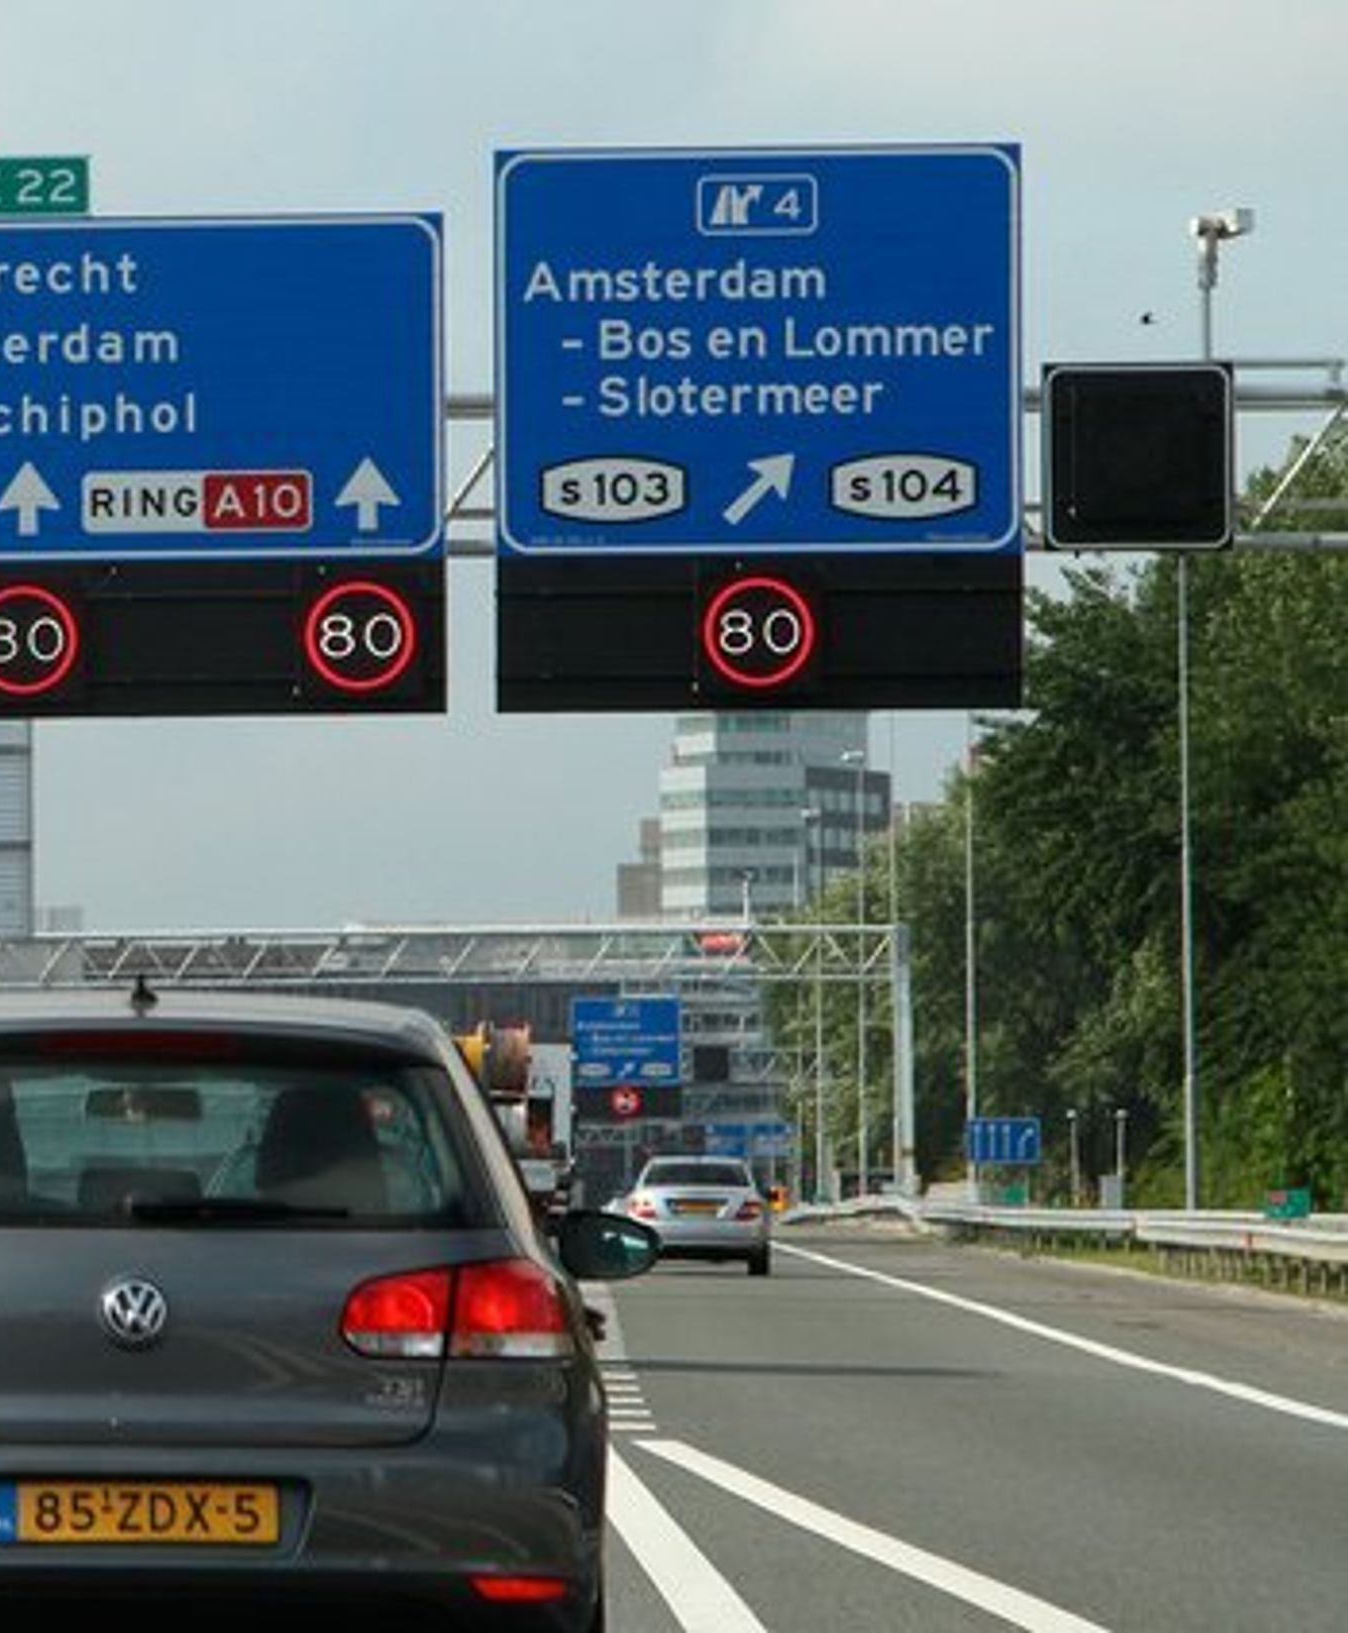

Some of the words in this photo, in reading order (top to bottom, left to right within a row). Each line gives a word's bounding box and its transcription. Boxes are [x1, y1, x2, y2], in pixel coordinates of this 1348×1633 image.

[16, 168, 77, 204] 22
[773, 189, 801, 219] 4
[523, 259, 825, 302] Amsterdam
[600, 319, 691, 360] Bos
[707, 326, 766, 359] en
[785, 317, 994, 357] Lommer
[599, 376, 884, 417] Slotermeer
[90, 487, 198, 518] RING
[213, 483, 302, 518] A10
[593, 473, 669, 507] 103
[883, 470, 963, 504] 104
[319, 613, 402, 658] 80
[719, 609, 800, 654] 80
